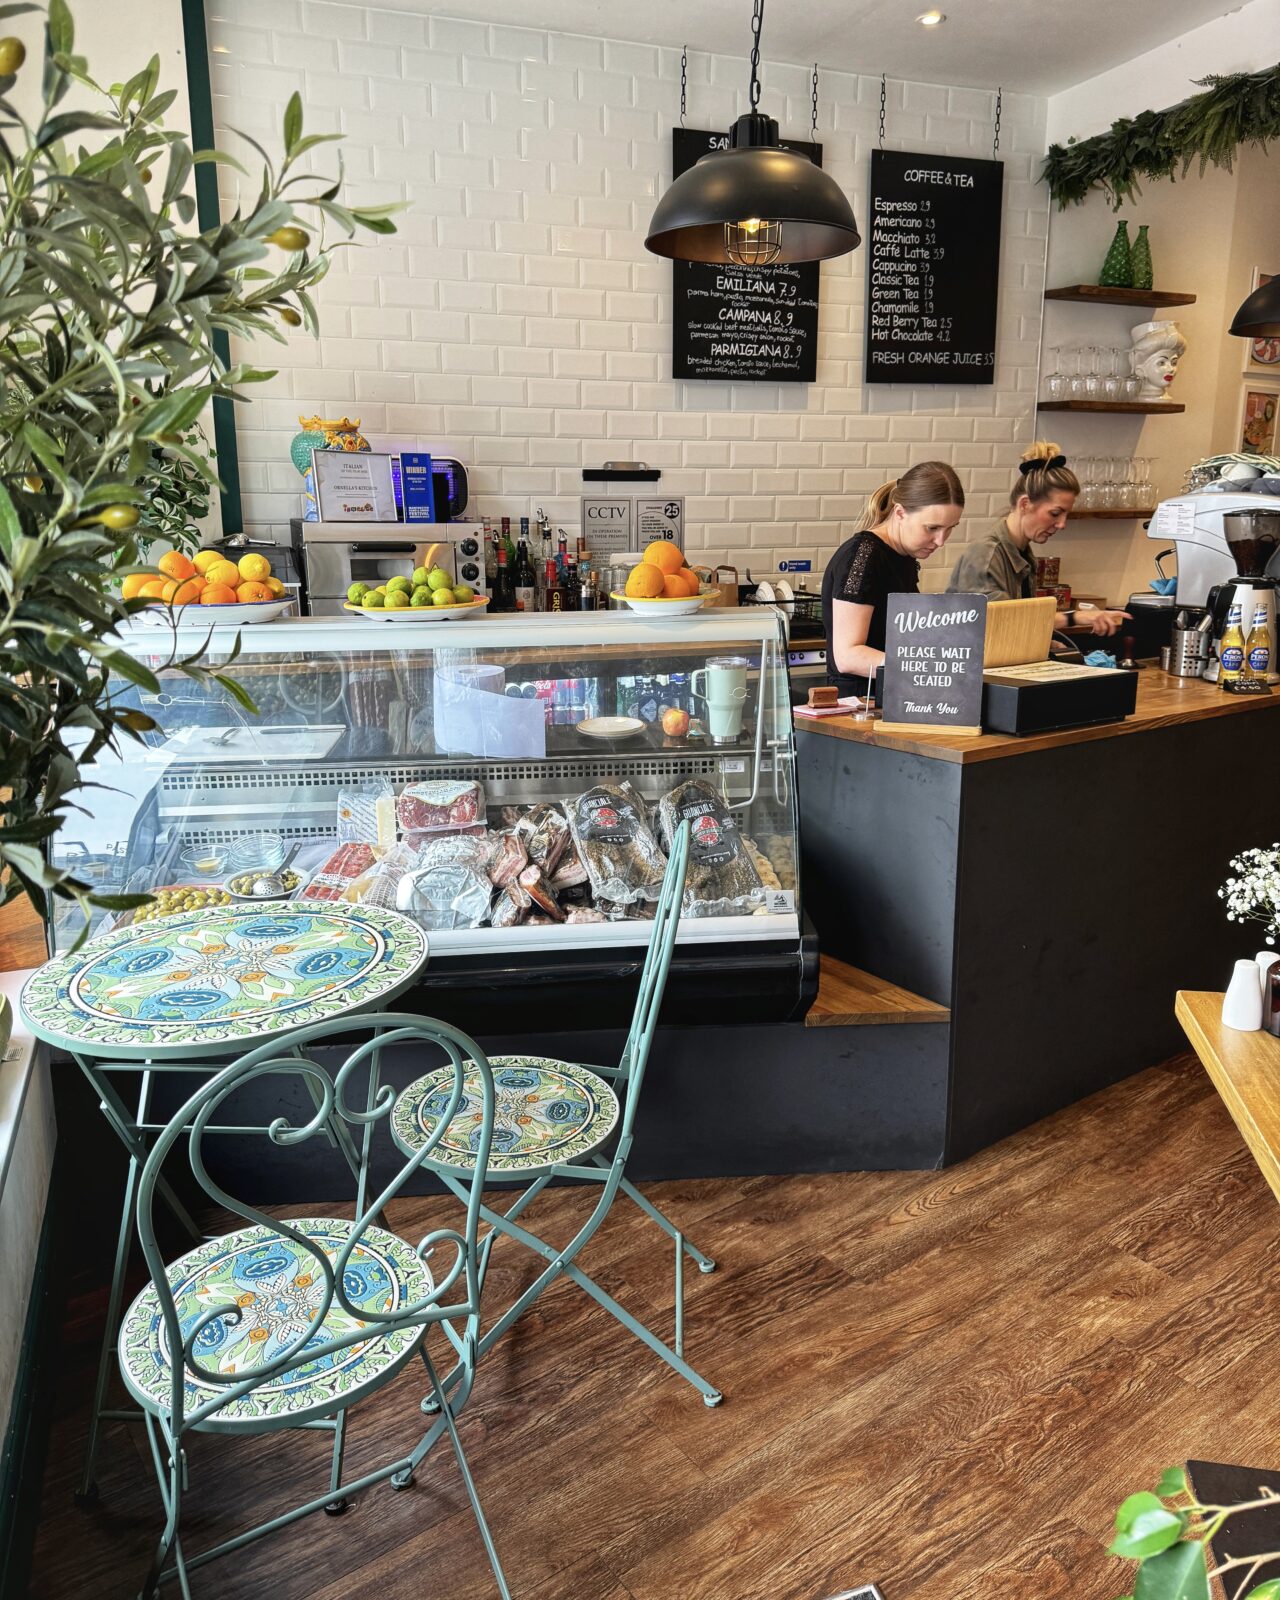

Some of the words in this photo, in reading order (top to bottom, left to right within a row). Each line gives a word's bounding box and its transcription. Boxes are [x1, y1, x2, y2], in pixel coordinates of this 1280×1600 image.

[904, 169, 944, 184] COFFEE
[953, 174, 974, 188] TEA
[874, 197, 917, 214] Espresso
[874, 215, 922, 228] Americano
[872, 230, 920, 244] Macchiato
[904, 246, 930, 259] Latte
[872, 259, 917, 274] Cappucino
[872, 273, 902, 286] Classic
[903, 274, 920, 286] Tea
[716, 276, 776, 294] EMILIANA
[778, 282, 796, 298] 7.9
[872, 287, 900, 300] Green
[902, 288, 919, 300] Tea
[872, 301, 920, 314] Chamomile
[718, 308, 772, 324] CAMPANA
[774, 310, 794, 326] 8.9
[872, 315, 890, 327] Red
[892, 315, 919, 330] Berry
[921, 317, 937, 328] Tea
[724, 322, 738, 331] beef
[871, 328, 889, 340] Hot
[891, 328, 934, 342] Chocolate
[711, 343, 782, 357] PARMIGIANA
[782, 344, 802, 359] 8.9
[872, 352, 905, 364] FRESH
[908, 352, 950, 364] ORANGE
[952, 352, 982, 366] JUICE
[588, 506, 626, 519] CCTV
[665, 505, 679, 517] 25
[662, 530, 674, 540] 18
[894, 609, 980, 634] Welcome
[898, 646, 936, 658] PLEASE
[942, 647, 972, 659] WAIT
[901, 660, 928, 672] HERE
[934, 662, 947, 673] TO
[952, 662, 966, 674] BE
[914, 674, 952, 688] SEATED
[904, 701, 934, 713] Thank
[936, 702, 960, 714] You
